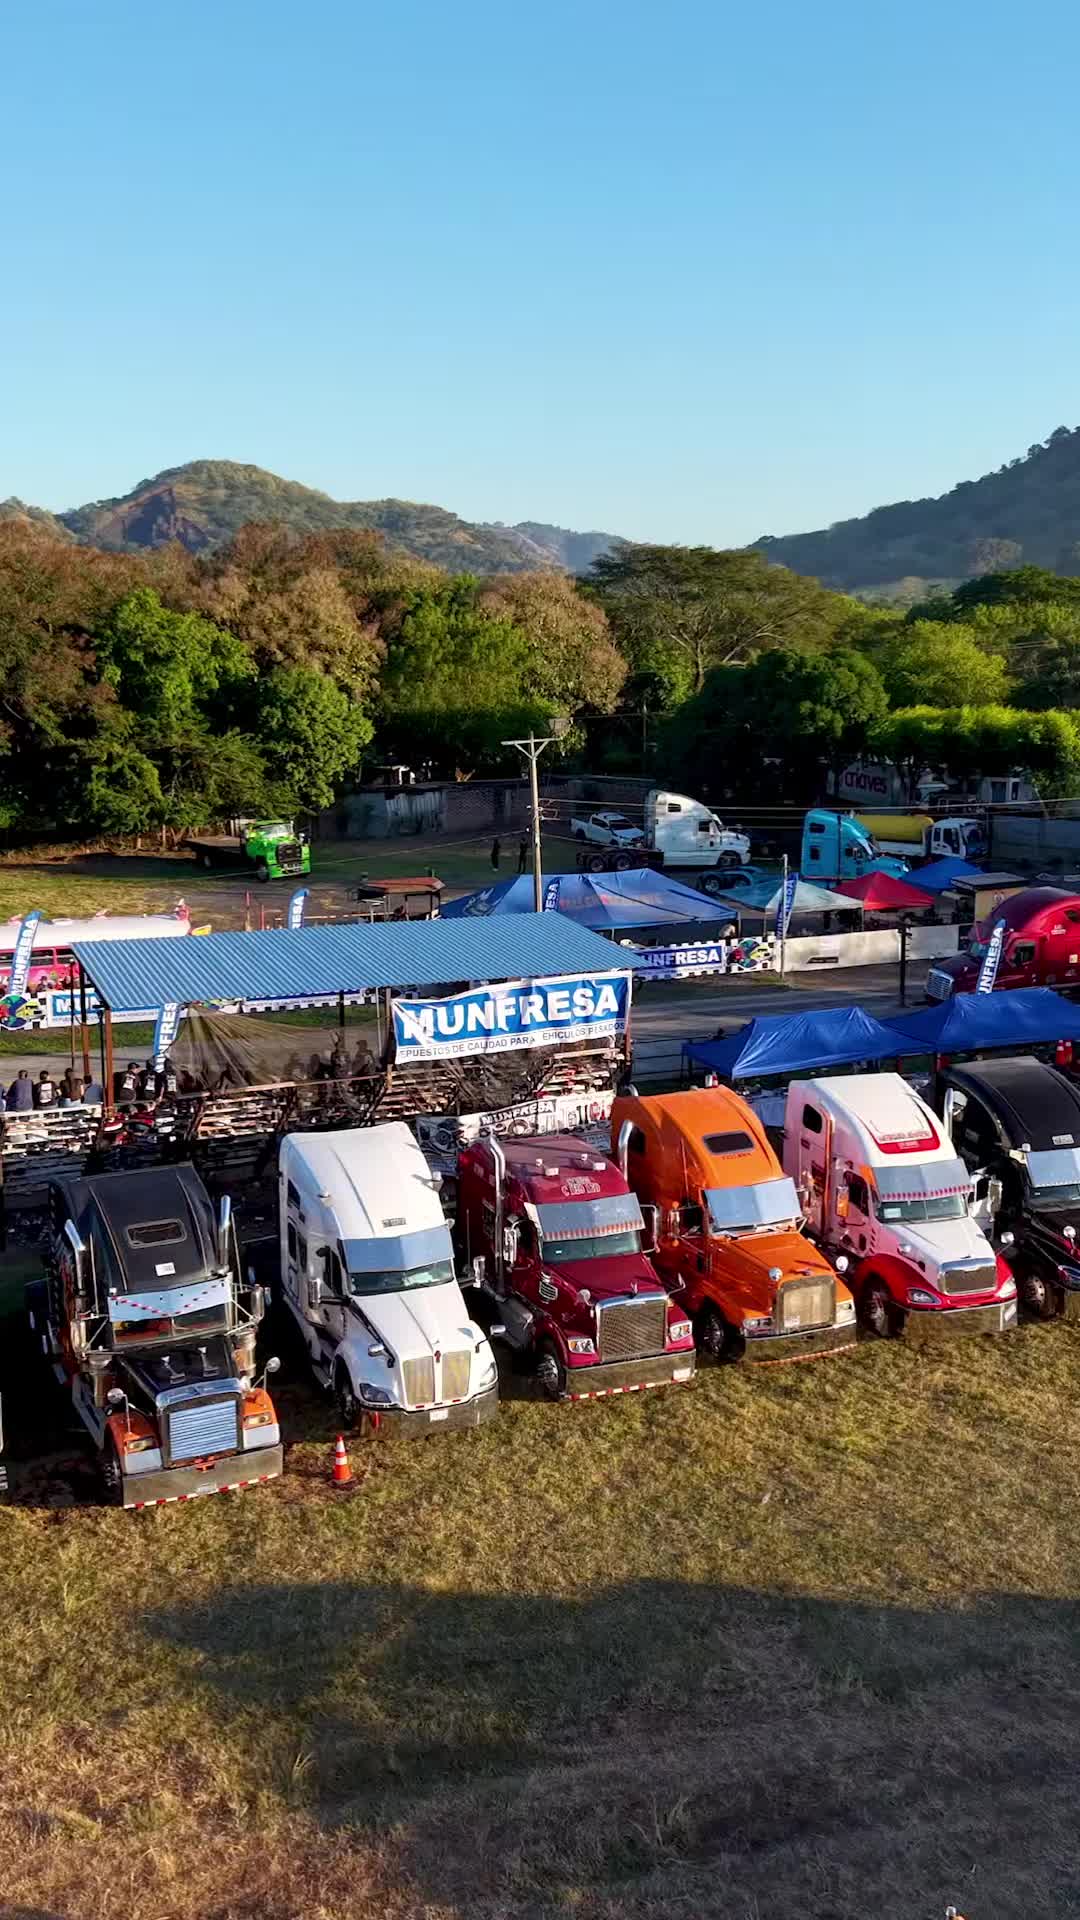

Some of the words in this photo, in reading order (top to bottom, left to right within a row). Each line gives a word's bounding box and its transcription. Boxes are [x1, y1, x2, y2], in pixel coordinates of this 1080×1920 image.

[402, 984, 618, 1039] MUNFRESA
[452, 1043, 465, 1054] DE
[467, 1038, 508, 1052] CALIDAD
[510, 1035, 535, 1047] PARA
[587, 1022, 625, 1036] PESADOS
